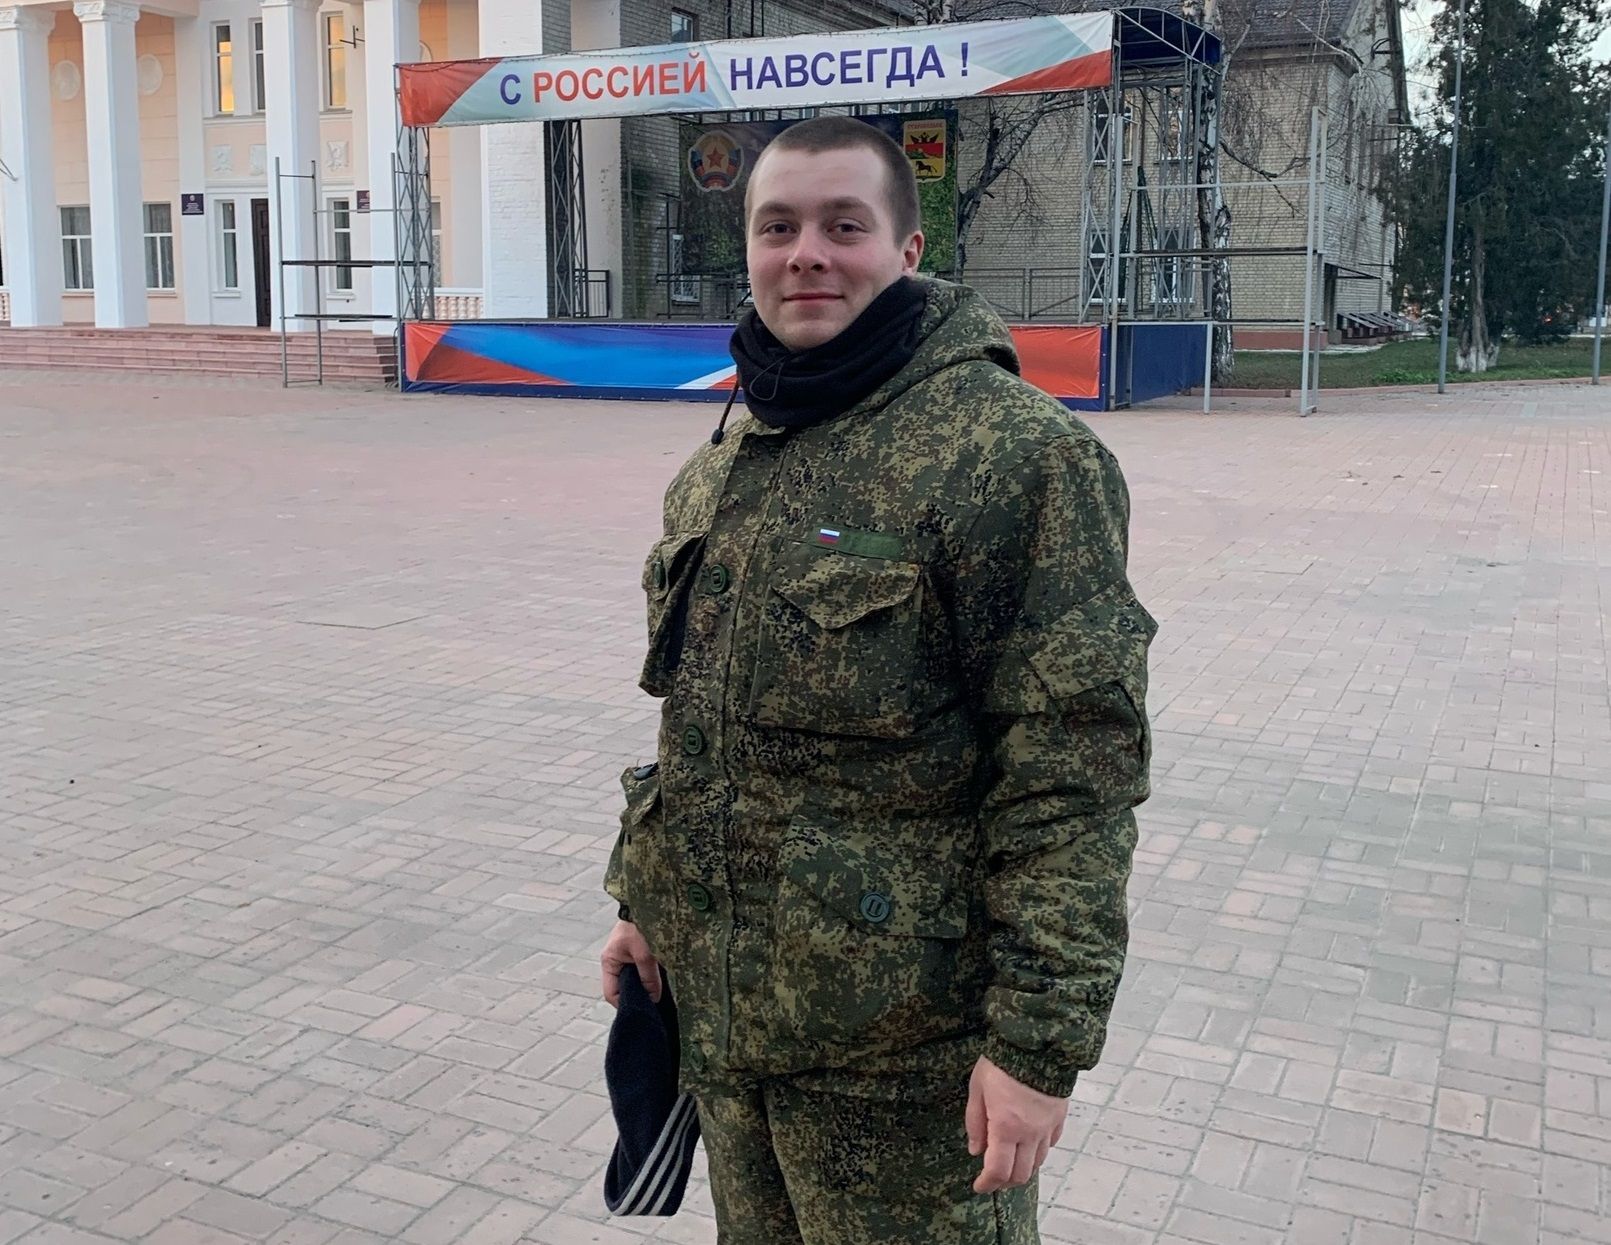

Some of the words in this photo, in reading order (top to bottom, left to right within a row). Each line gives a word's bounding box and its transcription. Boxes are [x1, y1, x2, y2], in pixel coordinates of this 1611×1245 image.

[500, 74, 521, 105] С
[533, 52, 706, 103] РОССИЕЙ
[730, 45, 945, 91] НАВСЕГДА
